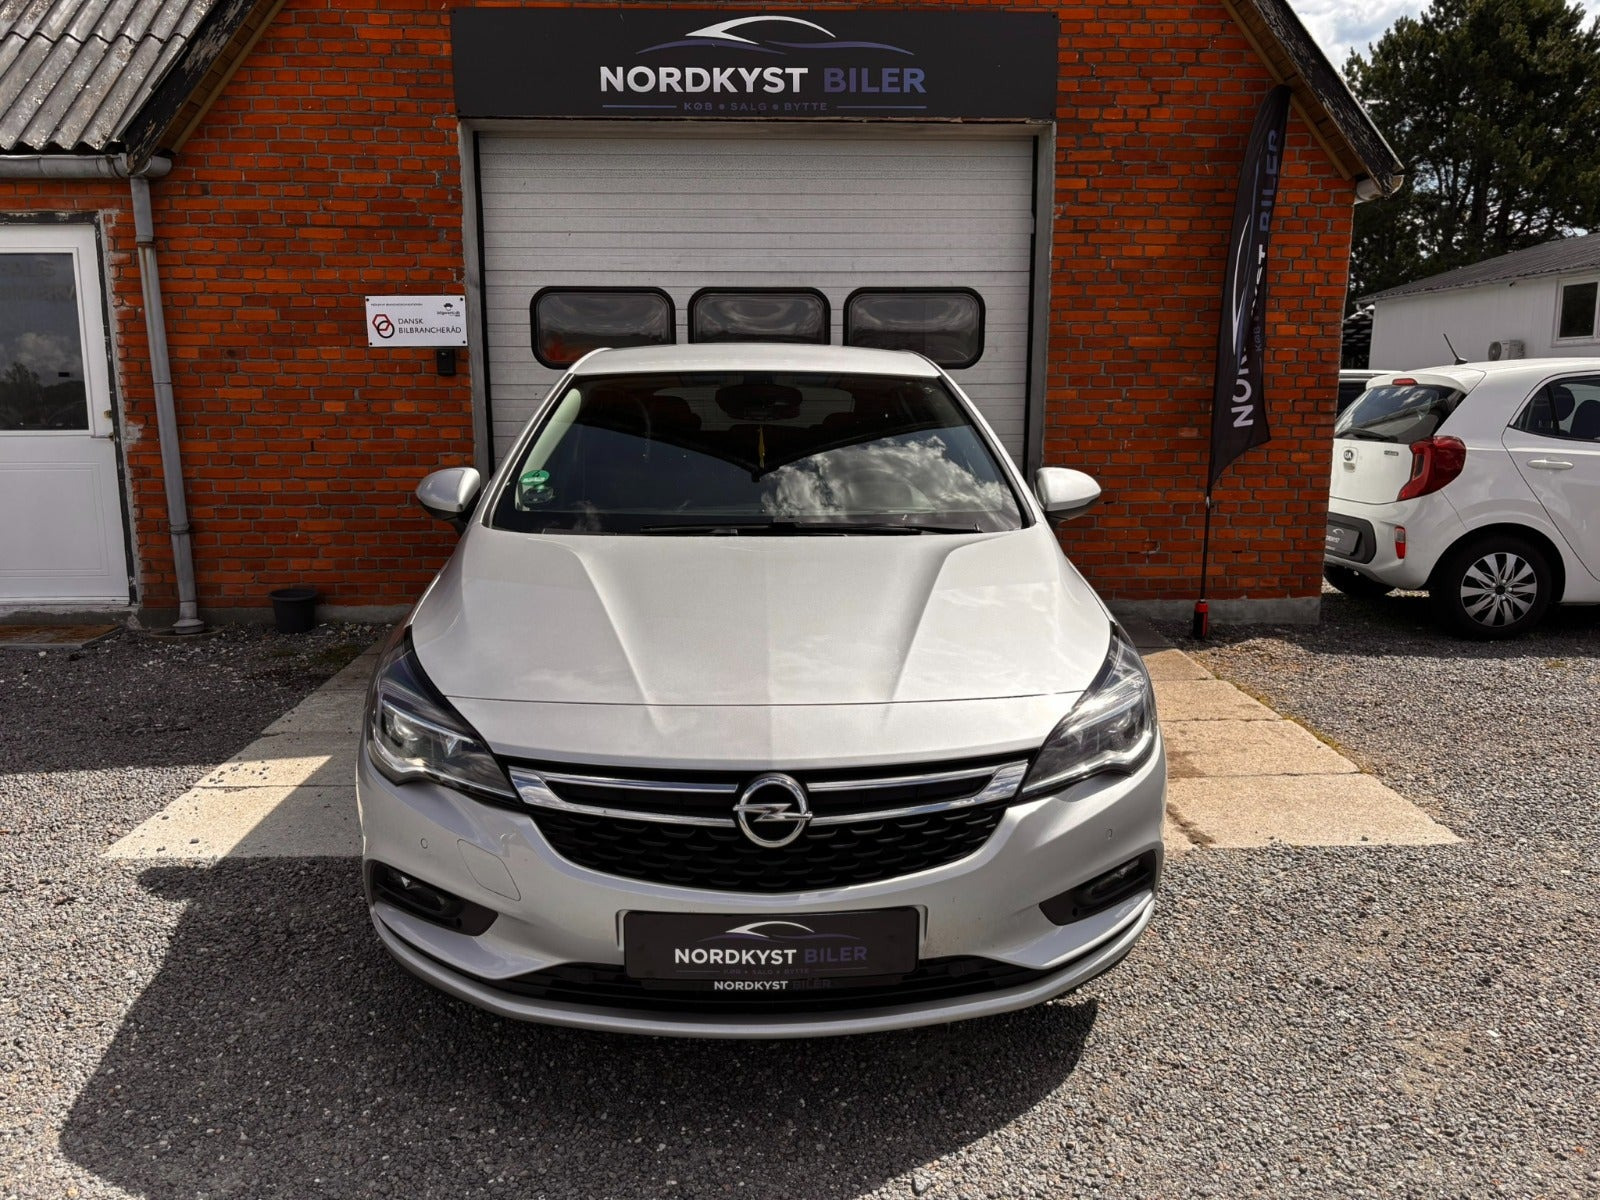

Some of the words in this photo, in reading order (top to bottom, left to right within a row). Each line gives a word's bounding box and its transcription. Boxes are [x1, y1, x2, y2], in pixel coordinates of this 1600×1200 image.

[599, 66, 808, 93] NORDKYST
[823, 67, 927, 94] BILER
[683, 102, 713, 111] KØB
[730, 102, 767, 112] SALG
[784, 102, 828, 111] BYTTE
[398, 326, 462, 334] BILBRANCHERÅD
[674, 948, 797, 965] NORDKYST
[804, 946, 868, 963] BILER
[713, 981, 789, 991] NORDKYST
